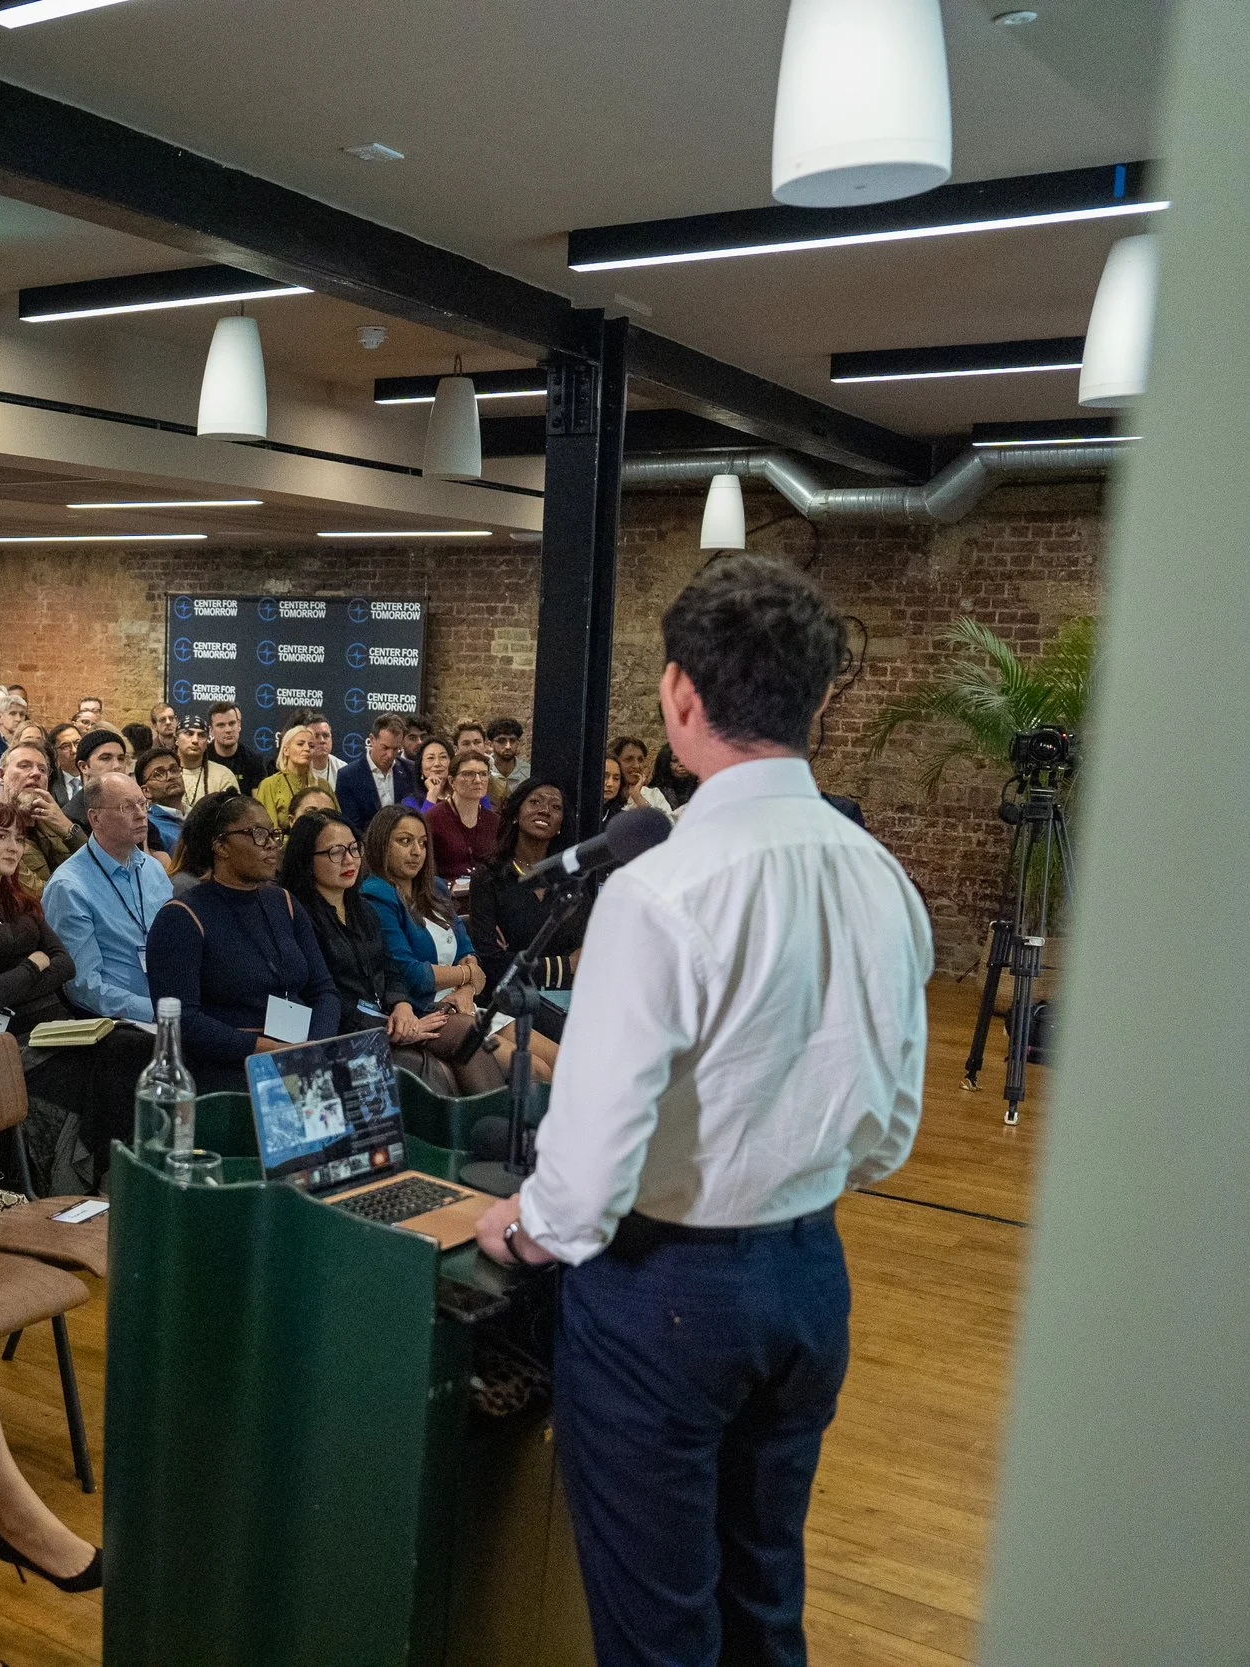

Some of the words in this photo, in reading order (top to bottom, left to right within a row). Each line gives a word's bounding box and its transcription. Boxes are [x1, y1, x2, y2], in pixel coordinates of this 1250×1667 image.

[223, 600, 237, 608] FOR
[279, 601, 309, 609] CENTER
[310, 601, 326, 609] FOR
[371, 602, 403, 611] CENTER
[404, 602, 421, 611] FOR
[194, 607, 238, 616] TOMORROW
[279, 609, 326, 618] TOMORROW
[370, 610, 421, 620] TOMORROW
[193, 641, 221, 650] CENTER
[222, 642, 236, 651] FOR
[278, 644, 308, 653] CENTER
[309, 645, 325, 654] FOR
[193, 650, 237, 659] TOMORROW
[369, 647, 401, 656] CENTER
[402, 648, 419, 657] FOR
[278, 653, 325, 663] TOMORROW
[368, 656, 418, 666] TOMORROW
[192, 684, 220, 693] CENTER
[221, 685, 236, 694] FOR
[277, 688, 306, 697] CENTER
[307, 690, 323, 698] FOR
[192, 692, 236, 702] TOMORROW
[276, 697, 323, 707] TOMORROW
[367, 692, 399, 702] CENTER
[400, 694, 416, 703] FOR
[367, 701, 416, 712] TOMORROW
